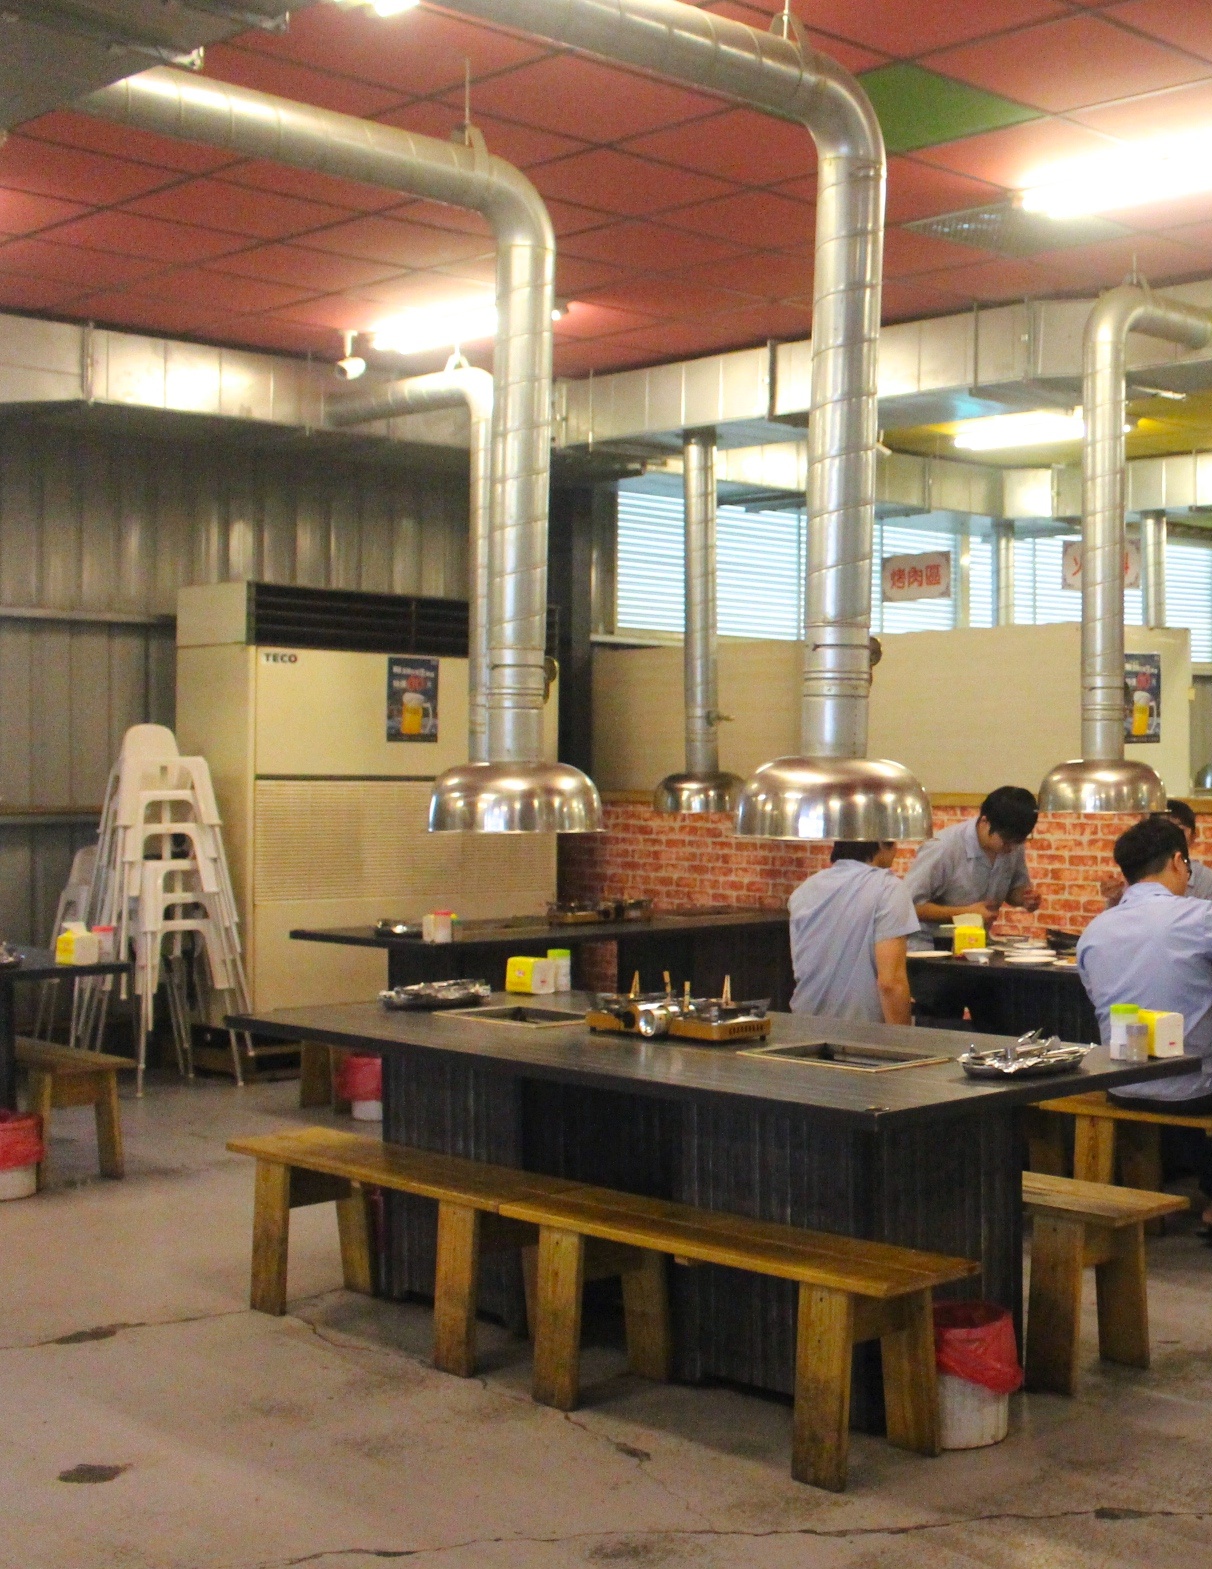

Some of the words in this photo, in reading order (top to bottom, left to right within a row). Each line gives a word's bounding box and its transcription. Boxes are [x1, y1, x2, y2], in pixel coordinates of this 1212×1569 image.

[889, 564, 942, 590] 烤肉區
[263, 652, 298, 663] TECO
